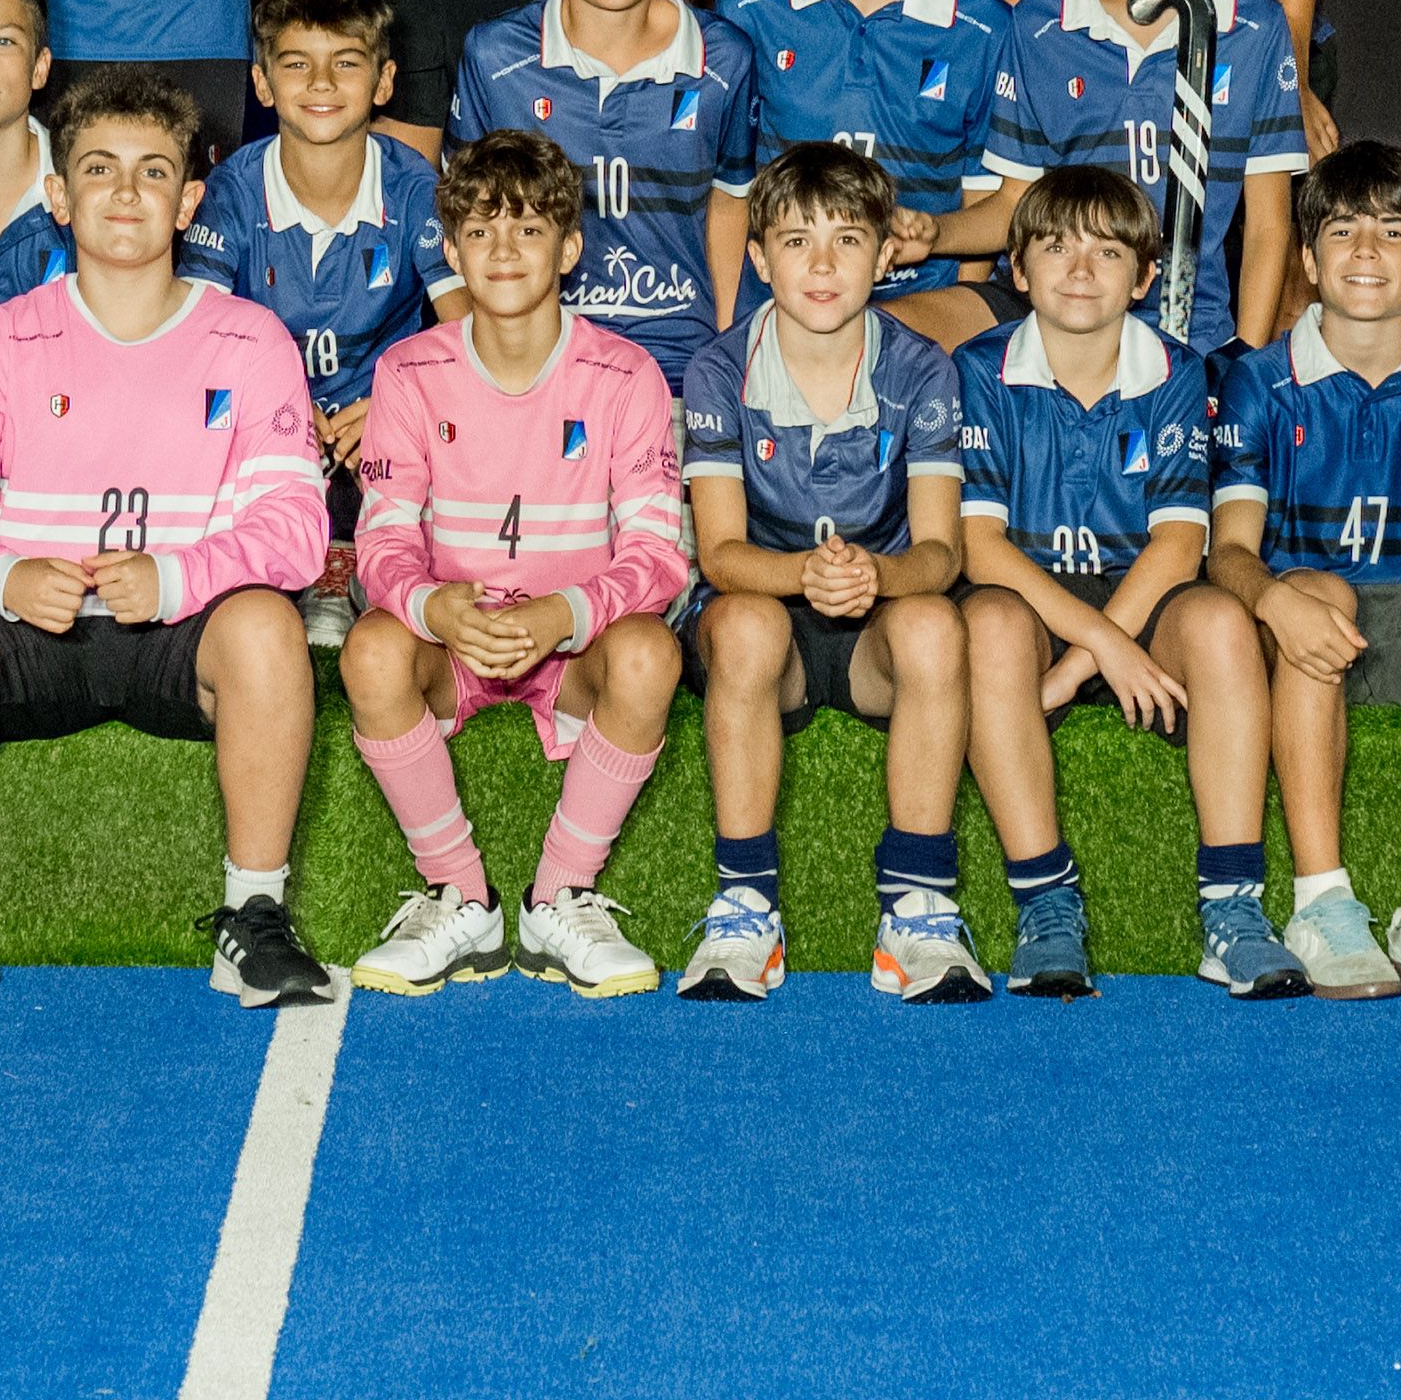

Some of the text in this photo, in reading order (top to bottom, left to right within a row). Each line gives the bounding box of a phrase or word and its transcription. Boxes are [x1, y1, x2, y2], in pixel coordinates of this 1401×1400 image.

[1124, 119, 1161, 185] 19
[593, 155, 630, 220] 10
[631, 264, 697, 305] Cuba
[98, 487, 150, 553] 23
[498, 494, 522, 559] 4
[1339, 496, 1390, 565] 47
